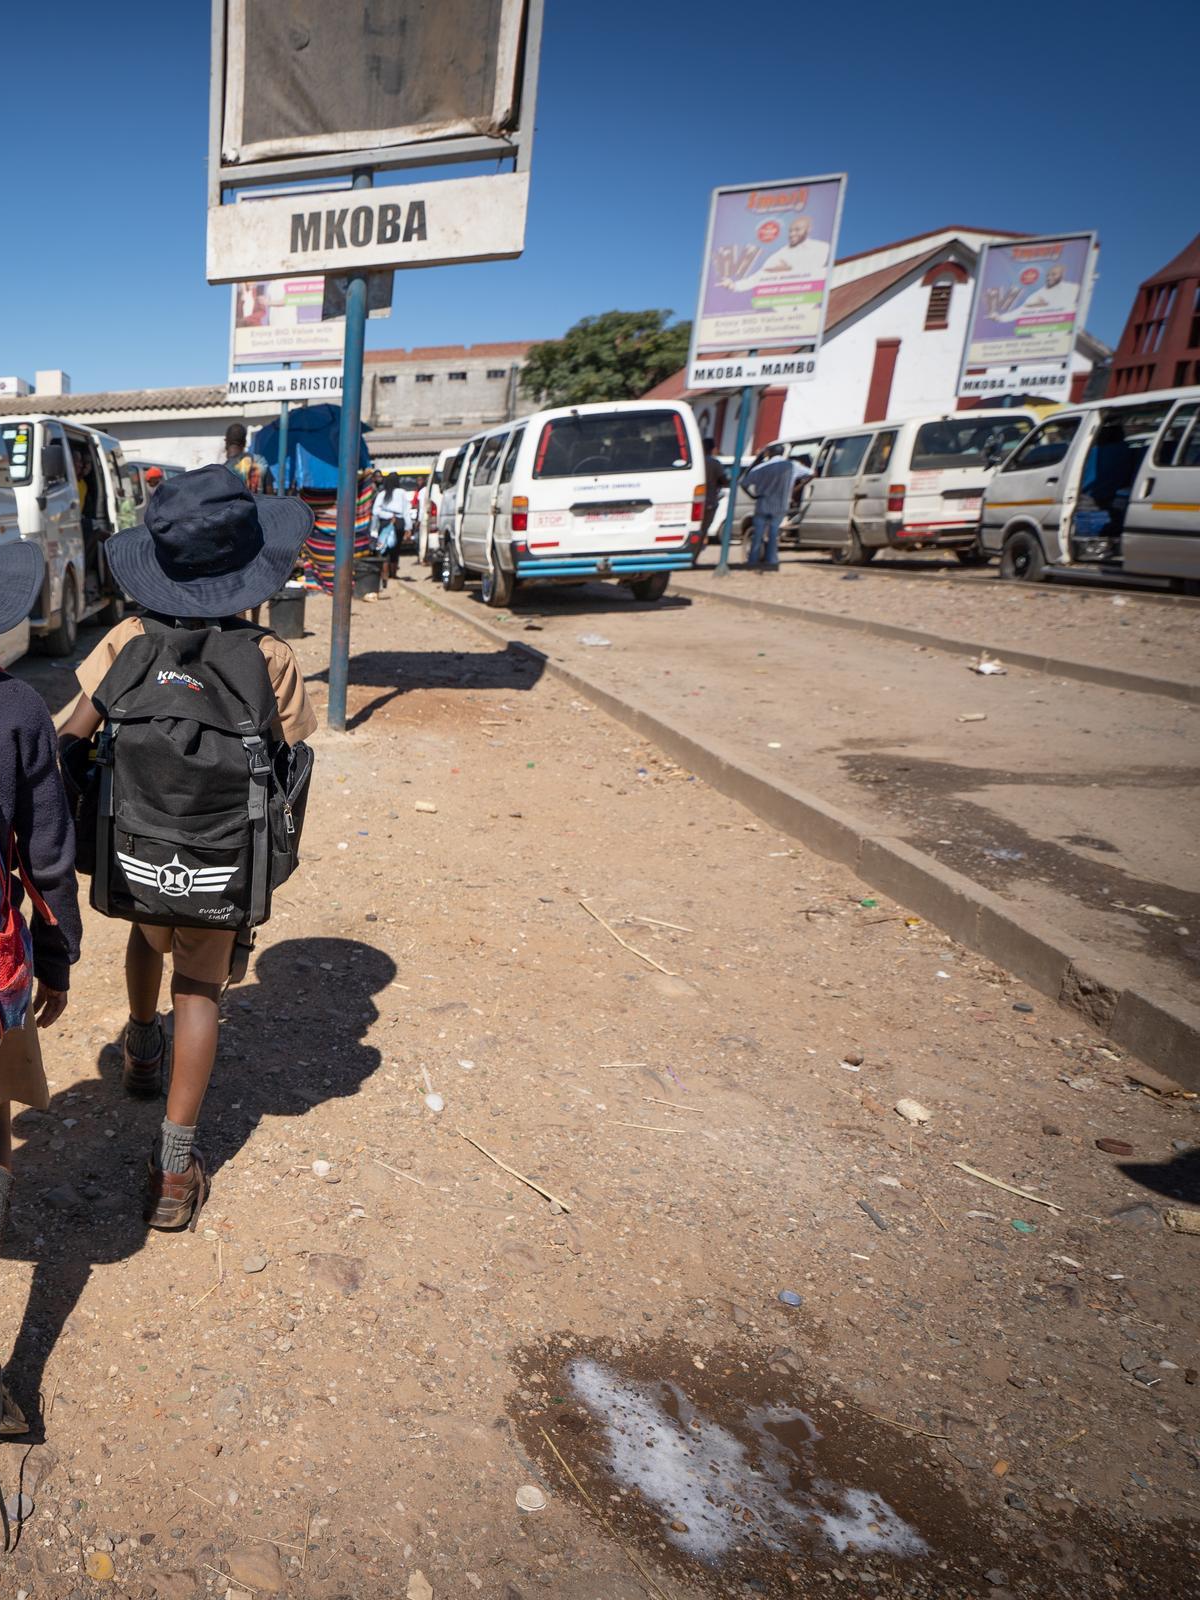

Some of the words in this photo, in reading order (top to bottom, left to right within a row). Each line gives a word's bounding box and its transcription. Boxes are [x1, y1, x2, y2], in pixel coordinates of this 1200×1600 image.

[290, 201, 427, 253] MKOBA
[694, 366, 743, 381] MKOBA
[760, 360, 815, 376] MAMBO
[228, 379, 274, 394] MKOBA
[962, 379, 1005, 391] MKOBA
[1019, 375, 1066, 387] MAMBO
